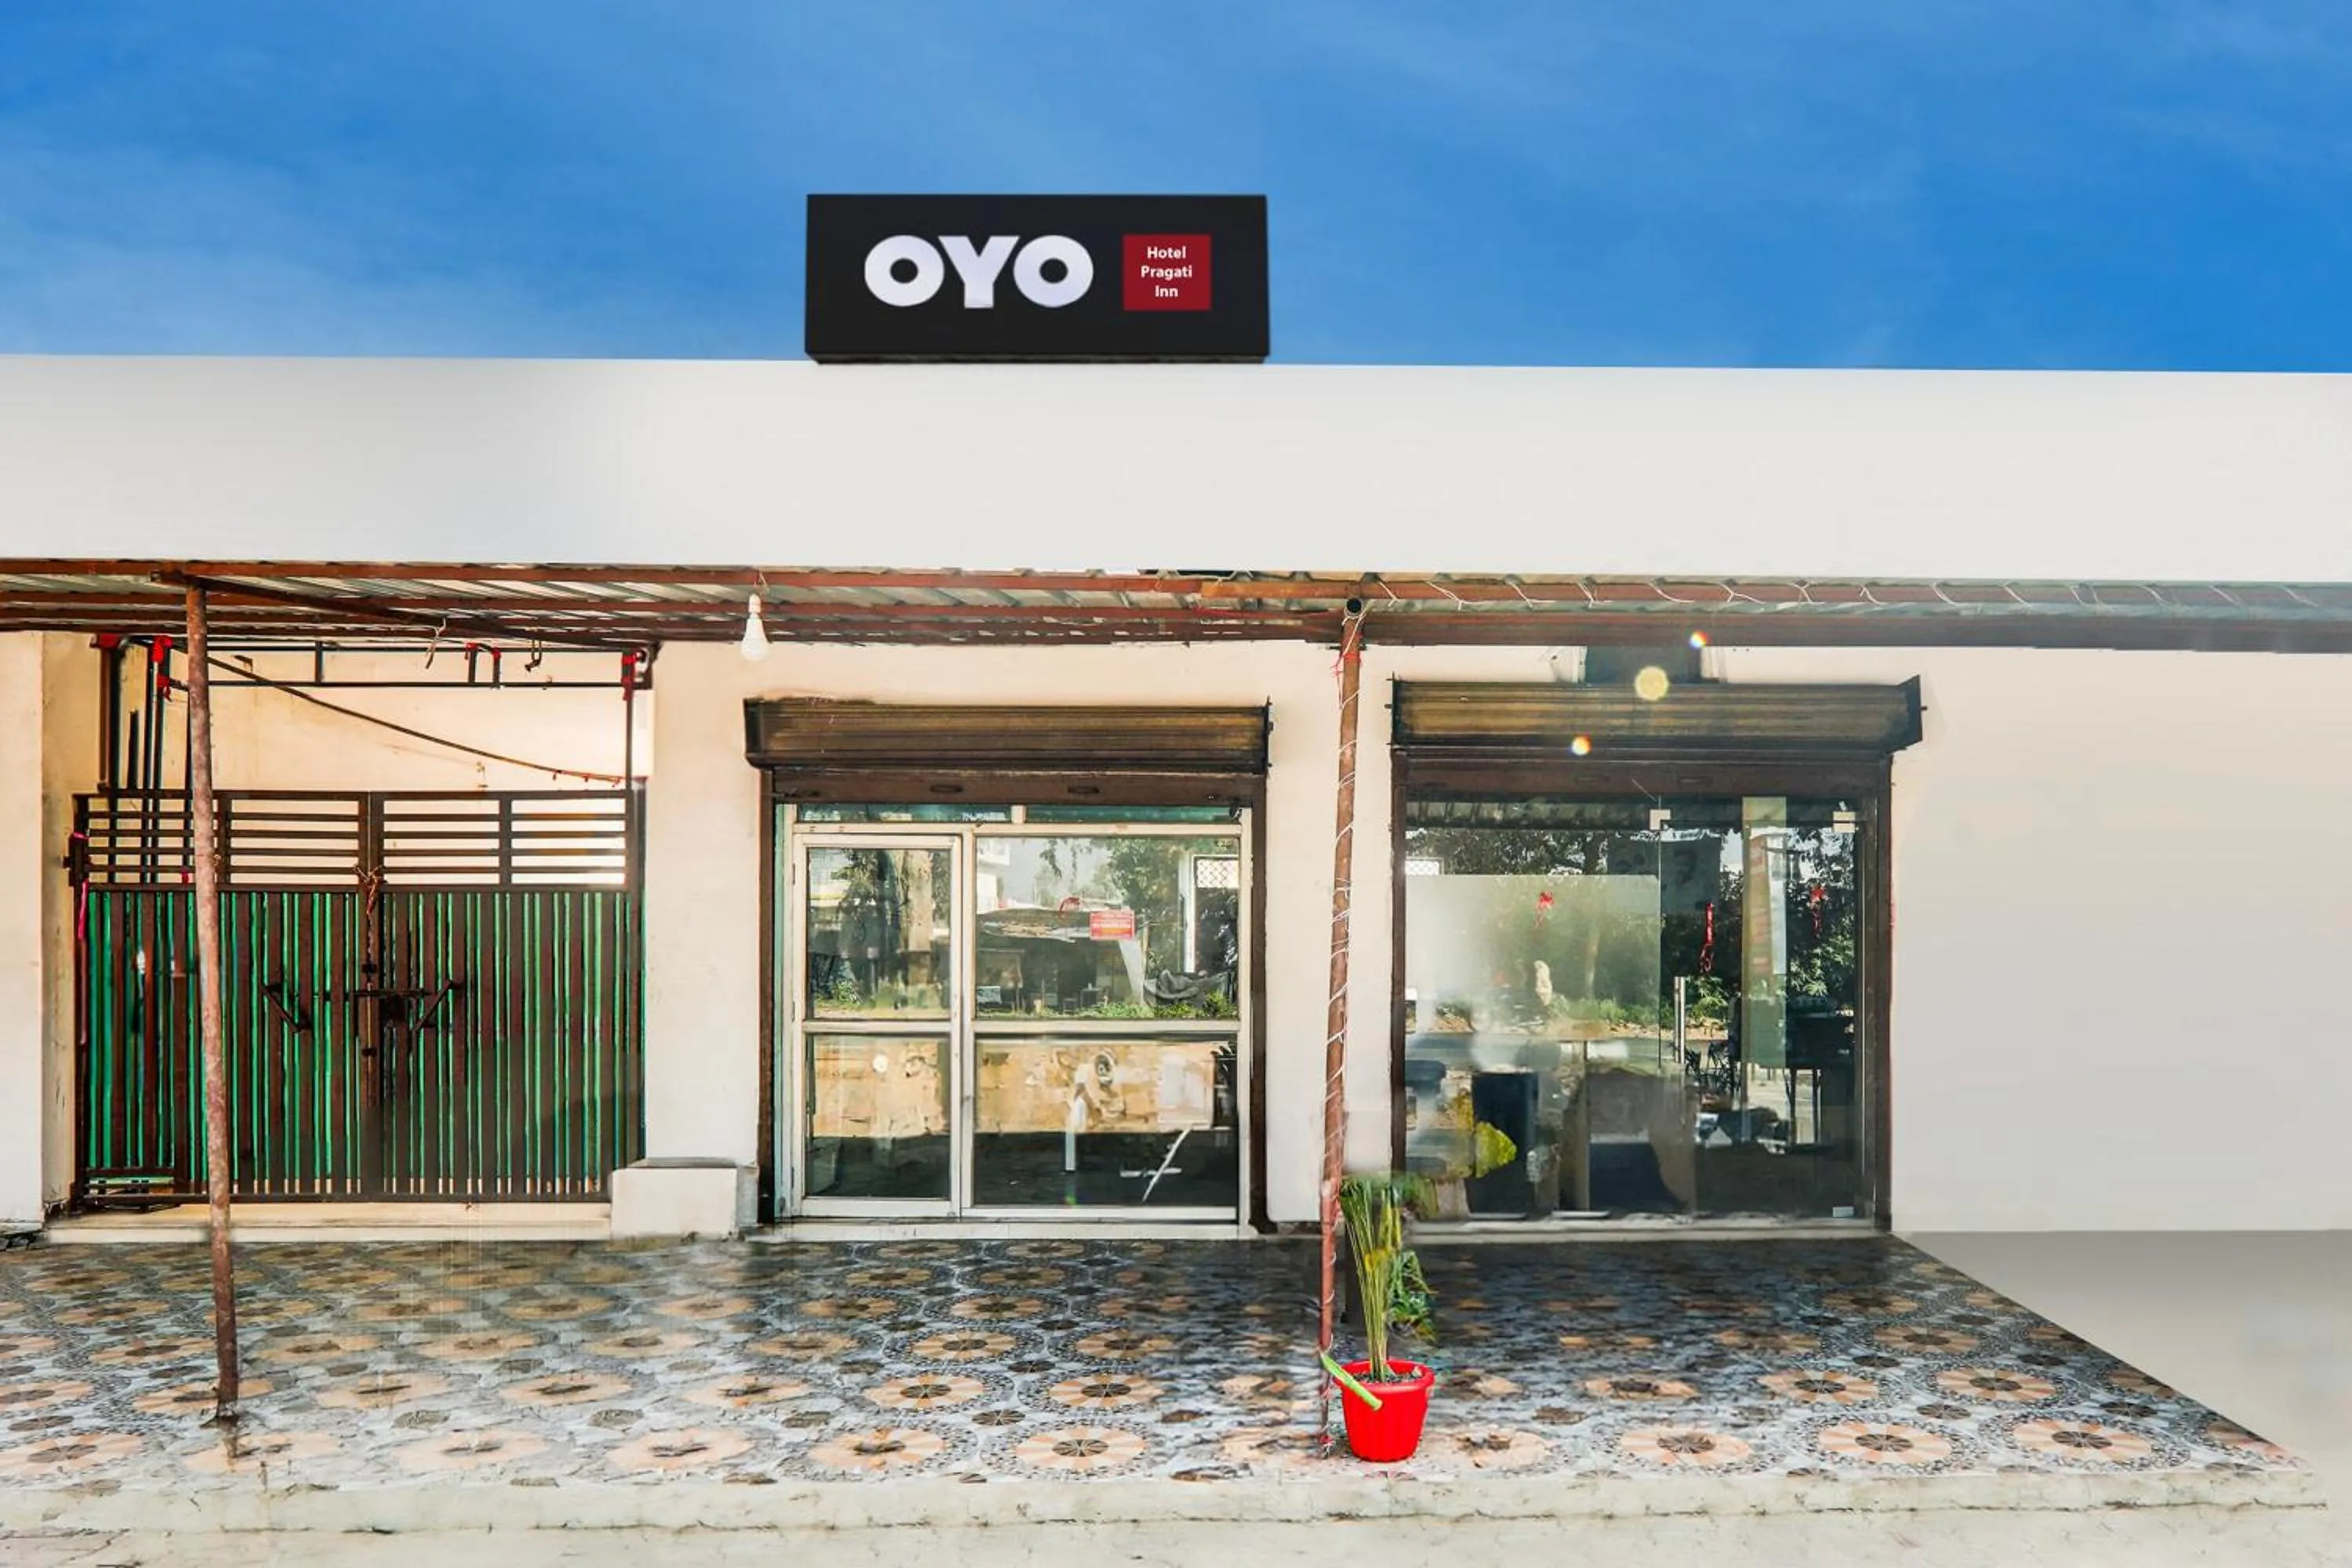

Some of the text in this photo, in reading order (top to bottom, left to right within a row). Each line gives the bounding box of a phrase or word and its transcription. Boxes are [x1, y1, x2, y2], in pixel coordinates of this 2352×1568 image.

[1147, 245, 1186, 259] Hotel
[864, 234, 1094, 309] OYO
[1141, 265, 1192, 281] Pragati
[1155, 285, 1178, 297] Inn
